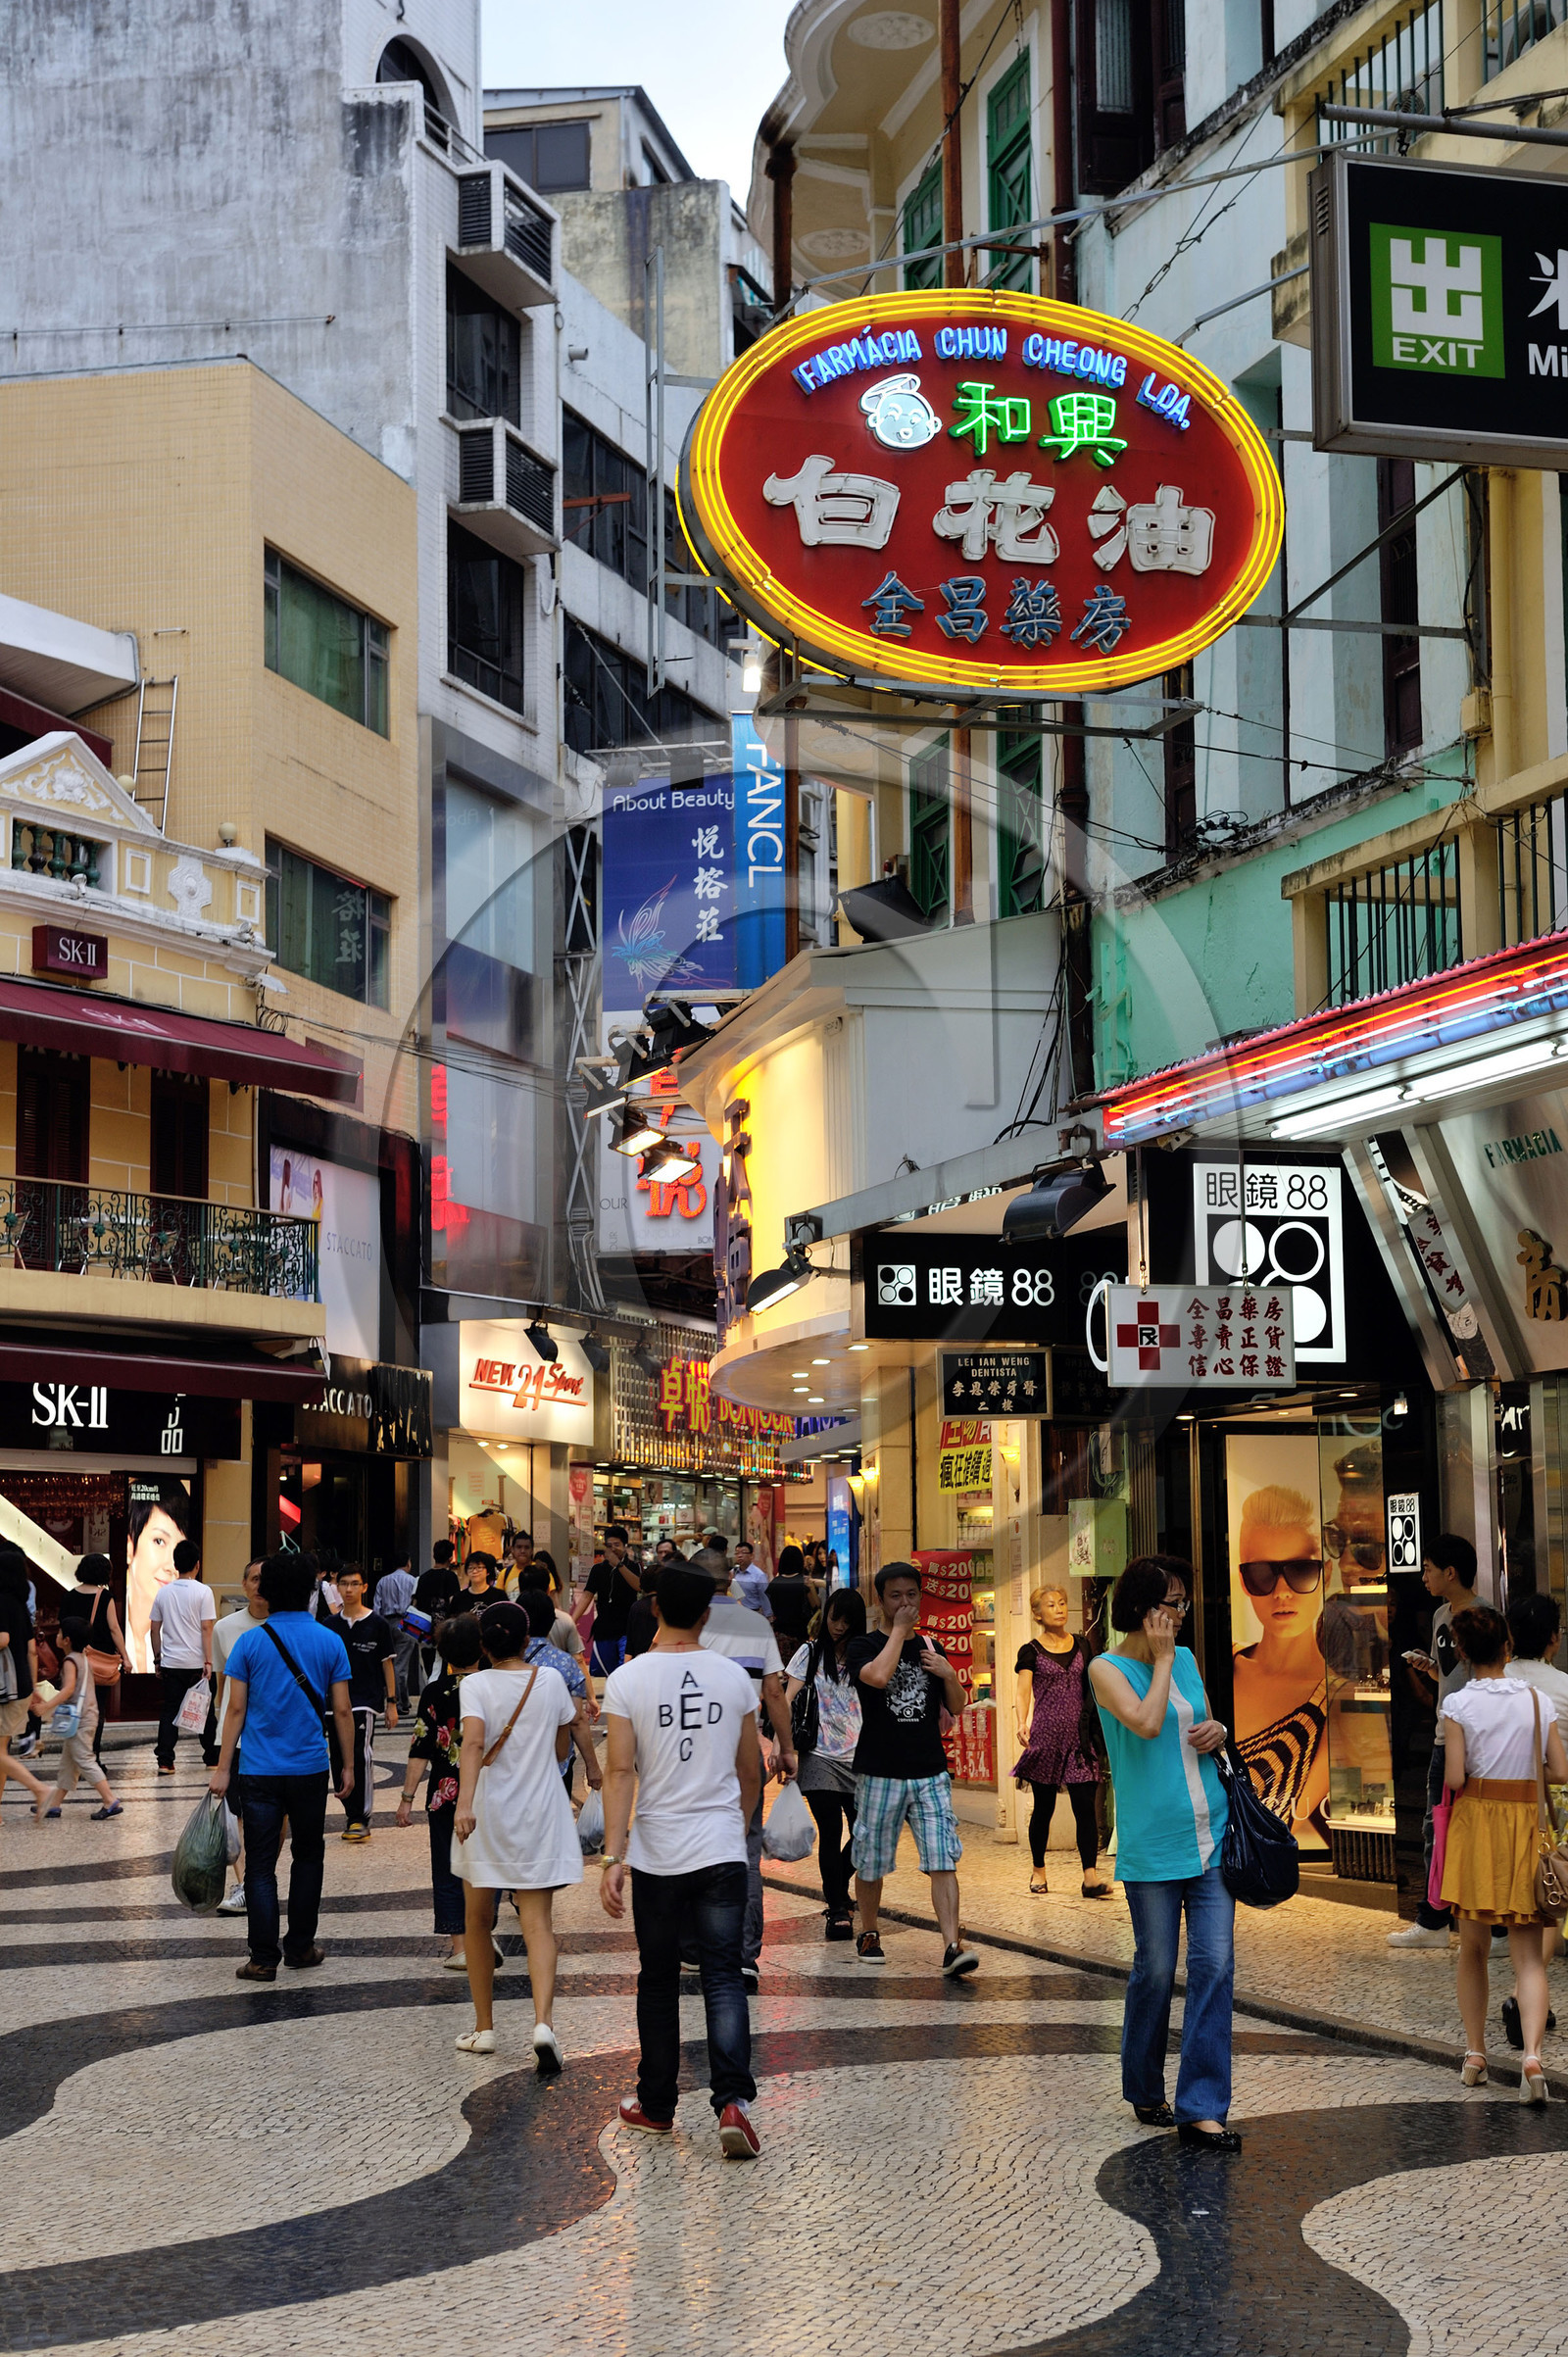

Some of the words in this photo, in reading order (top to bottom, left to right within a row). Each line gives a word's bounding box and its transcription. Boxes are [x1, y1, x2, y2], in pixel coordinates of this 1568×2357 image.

[1392, 336, 1484, 368] EXIT
[791, 324, 922, 394] FARMÁCIA
[935, 326, 1008, 361] CHUN
[1023, 332, 1128, 387] CHEONG
[1136, 368, 1192, 430] LDA.
[950, 380, 1128, 466] 和興
[762, 454, 1215, 576] 白花油
[860, 569, 1132, 654] 全昌藥房
[612, 792, 666, 813] About
[671, 789, 735, 810] Beauty
[1484, 1128, 1562, 1168] FARMACIA
[326, 1232, 372, 1261] STACCATO
[928, 1267, 1055, 1306] 眼鏡88
[1187, 1297, 1284, 1321] 全昌藥房
[1188, 1324, 1285, 1350] 專賣正貨
[957, 1357, 973, 1366] LEI
[979, 1357, 996, 1366] IAN
[1002, 1356, 1030, 1366] WENG
[971, 1368, 1016, 1377] DENTISTA
[1188, 1353, 1287, 1378] 信心保證
[473, 1357, 515, 1386] NEW
[513, 1363, 545, 1410] 21
[544, 1363, 583, 1397] Sport
[681, 1670, 699, 1689] A
[679, 1737, 693, 1762] C
